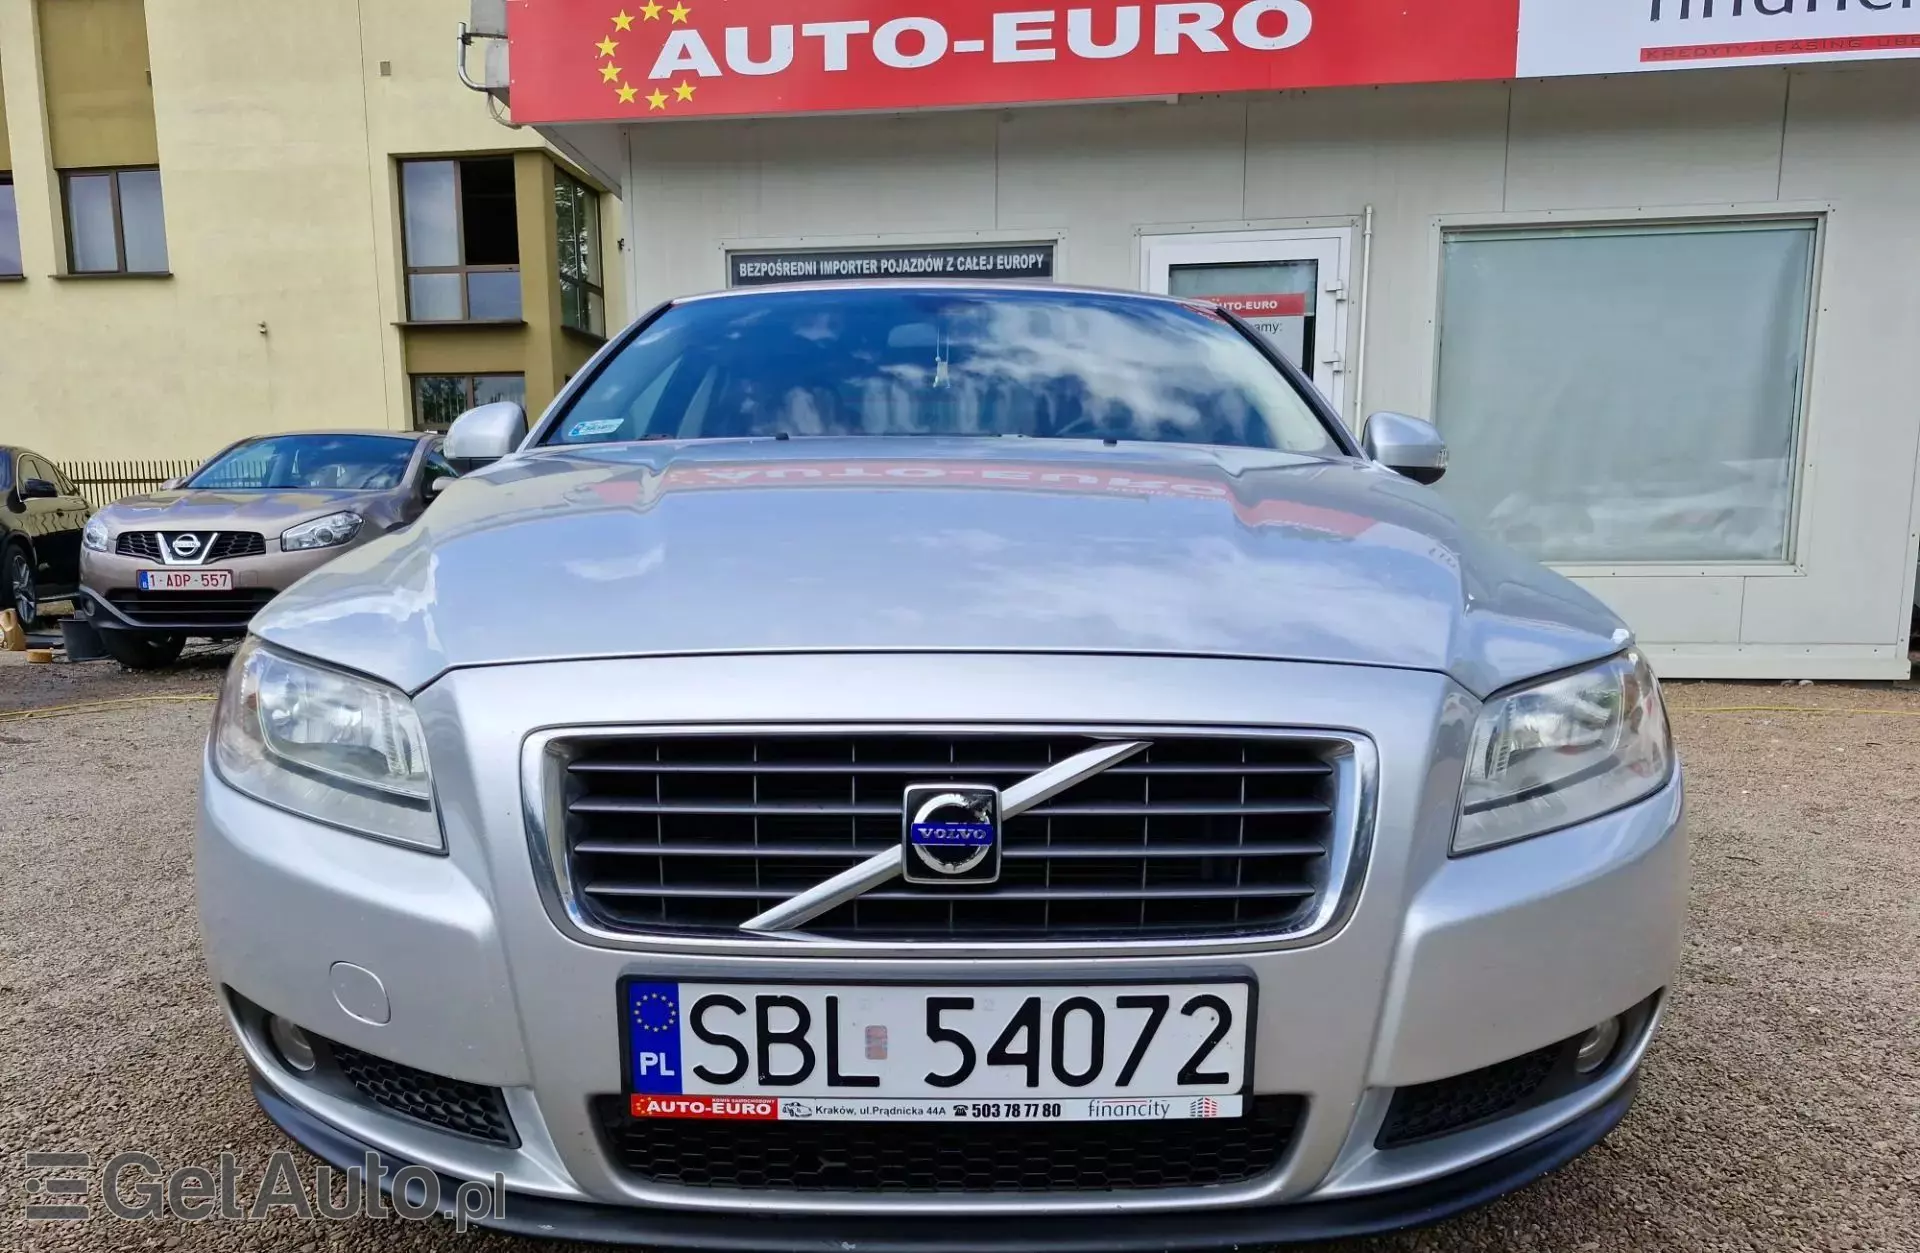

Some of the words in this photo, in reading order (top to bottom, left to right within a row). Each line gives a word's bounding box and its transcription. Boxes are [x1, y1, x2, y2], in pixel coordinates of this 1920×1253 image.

[647, 0, 1313, 80] AUTO-EURO
[739, 259, 817, 278] BEZPOŚREDNI
[820, 259, 878, 276] IMPORTER
[880, 255, 944, 274] POJAZDÓW
[946, 256, 954, 272] Z
[956, 255, 994, 271] CAŁEJ
[997, 254, 1044, 270] EUROPY
[917, 828, 987, 840] VOLVO
[689, 993, 881, 1088] SBL
[924, 994, 1231, 1088] 54072
[639, 1051, 676, 1076] PL
[646, 1100, 772, 1115] AUTO-EURO
[815, 1105, 857, 1116] Kraków,
[926, 1106, 946, 1116] 44A
[972, 1103, 1001, 1118] 503
[1003, 1103, 1021, 1118] 78
[1024, 1103, 1039, 1118] 77
[1042, 1103, 1061, 1118] 80
[1088, 1099, 1171, 1119] financity
